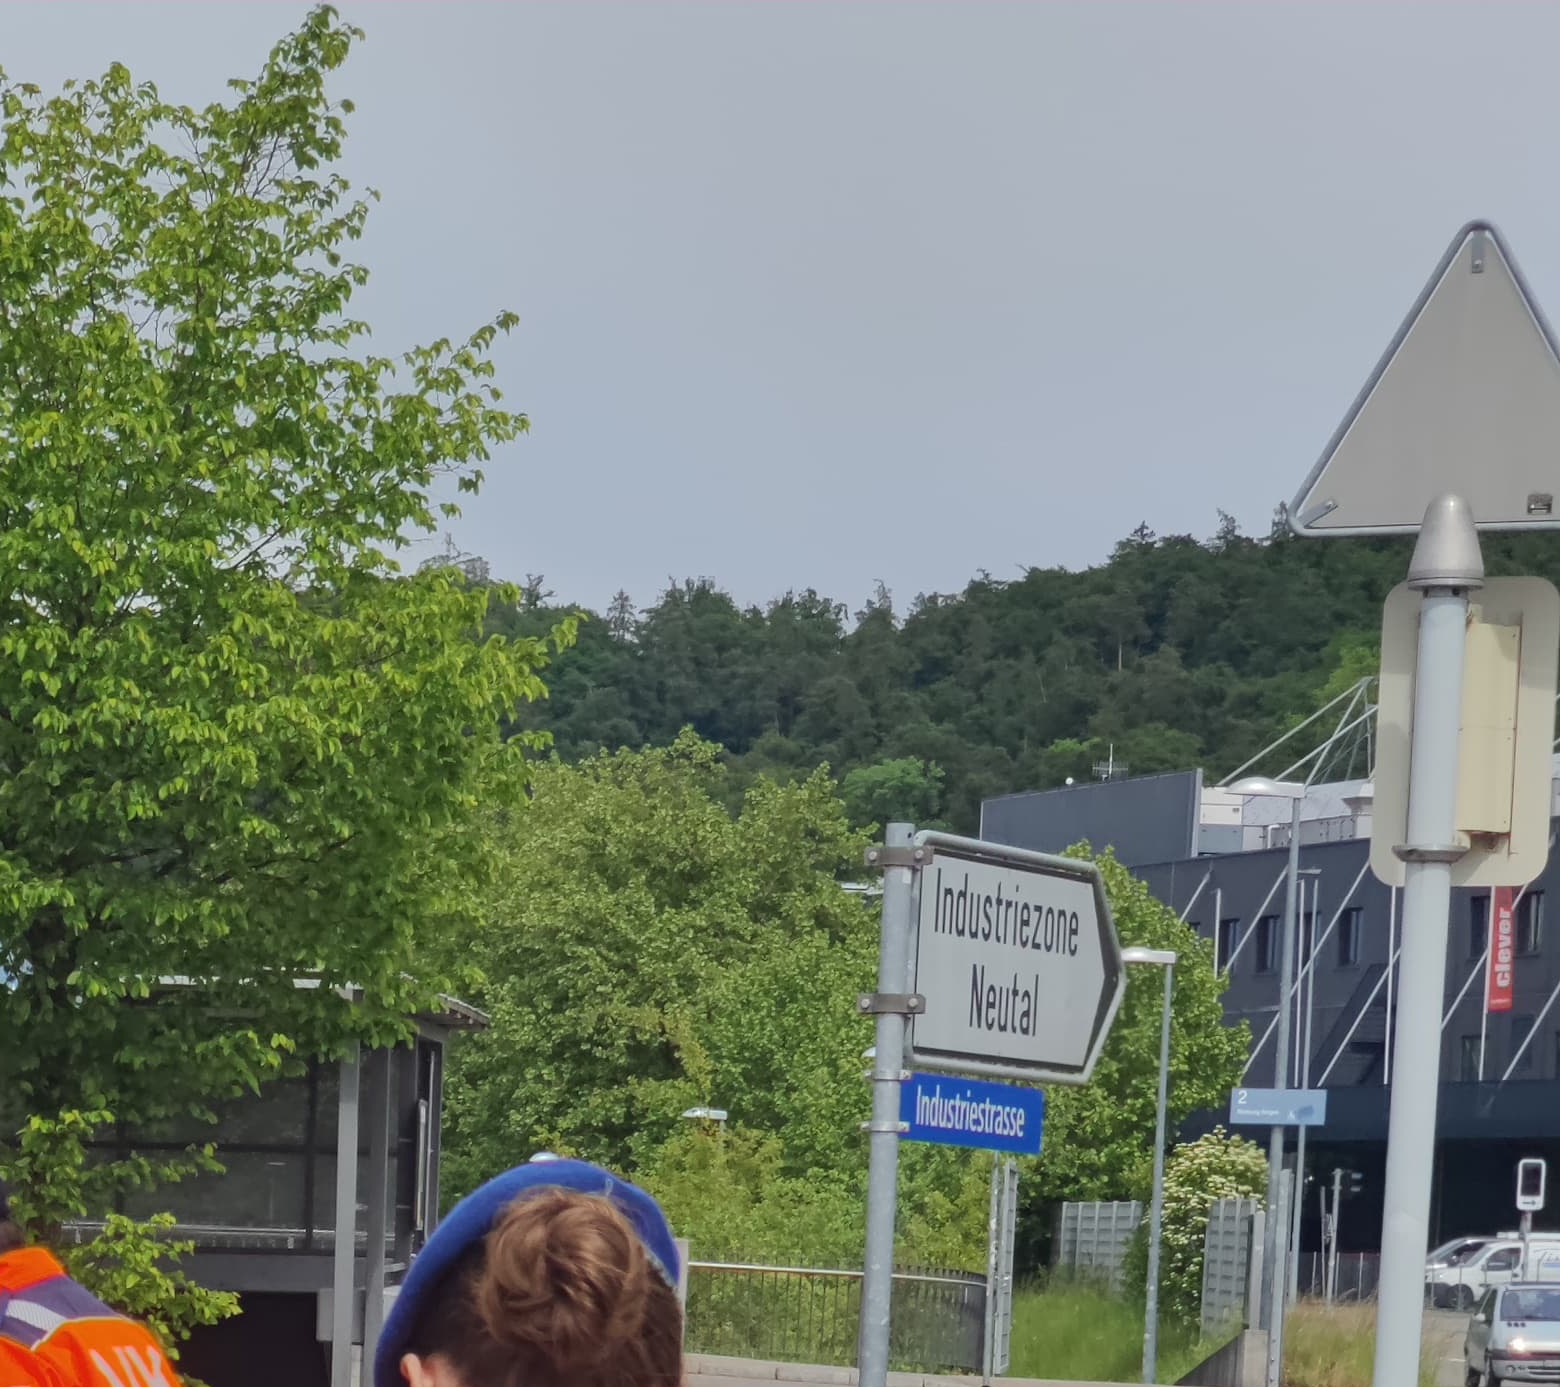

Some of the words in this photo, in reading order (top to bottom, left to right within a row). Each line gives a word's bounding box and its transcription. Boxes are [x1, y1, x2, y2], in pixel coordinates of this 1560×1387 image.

[934, 868, 1079, 956] Industriezone
[1495, 907, 1512, 987] clever
[969, 964, 1039, 1037] Neutal
[915, 1084, 1025, 1137] Industriestrasse
[1237, 1090, 1248, 1104] 2
